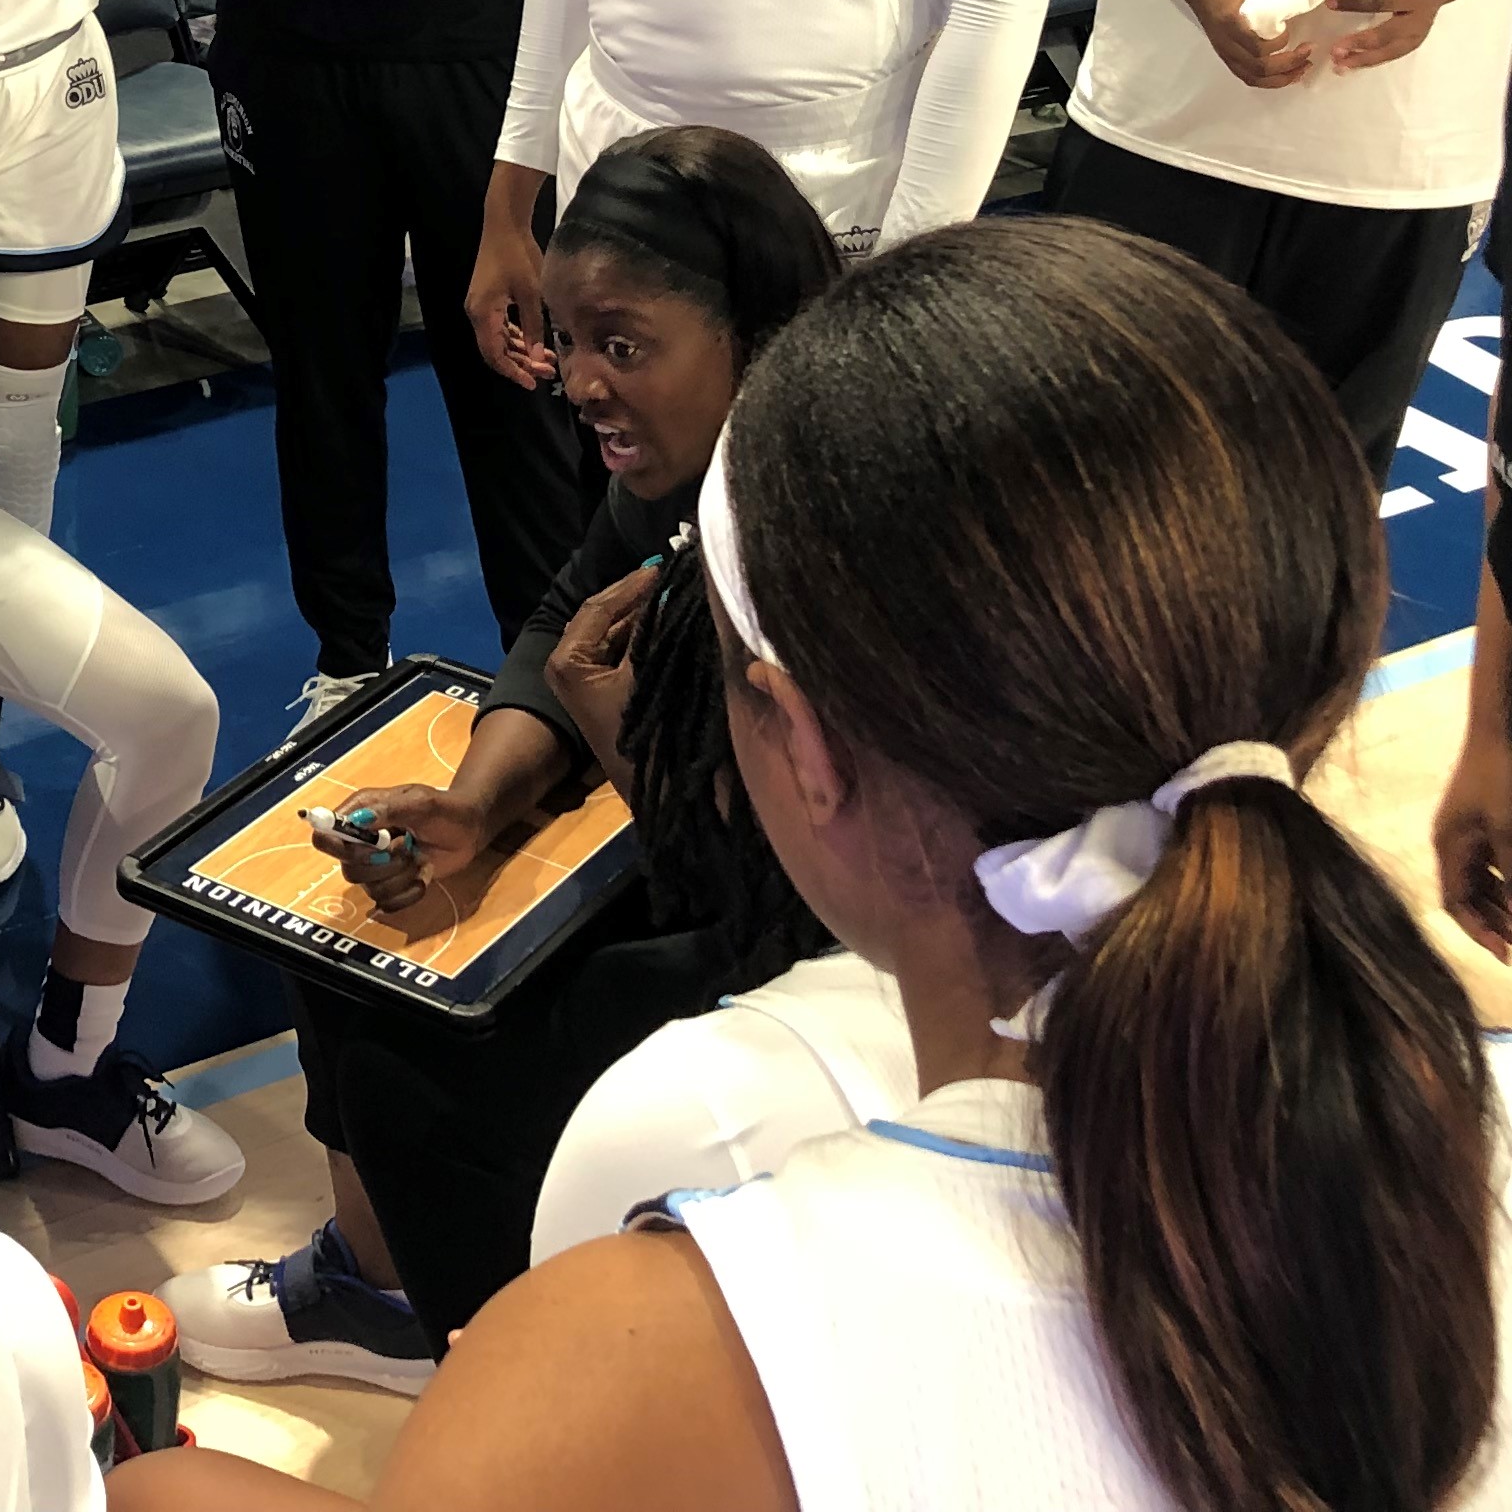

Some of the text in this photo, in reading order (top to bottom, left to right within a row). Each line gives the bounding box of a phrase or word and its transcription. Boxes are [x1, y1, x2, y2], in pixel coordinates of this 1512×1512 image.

[65, 73, 107, 109] ODU
[445, 685, 480, 704] OL
[182, 875, 439, 987] OLD DOMINION
